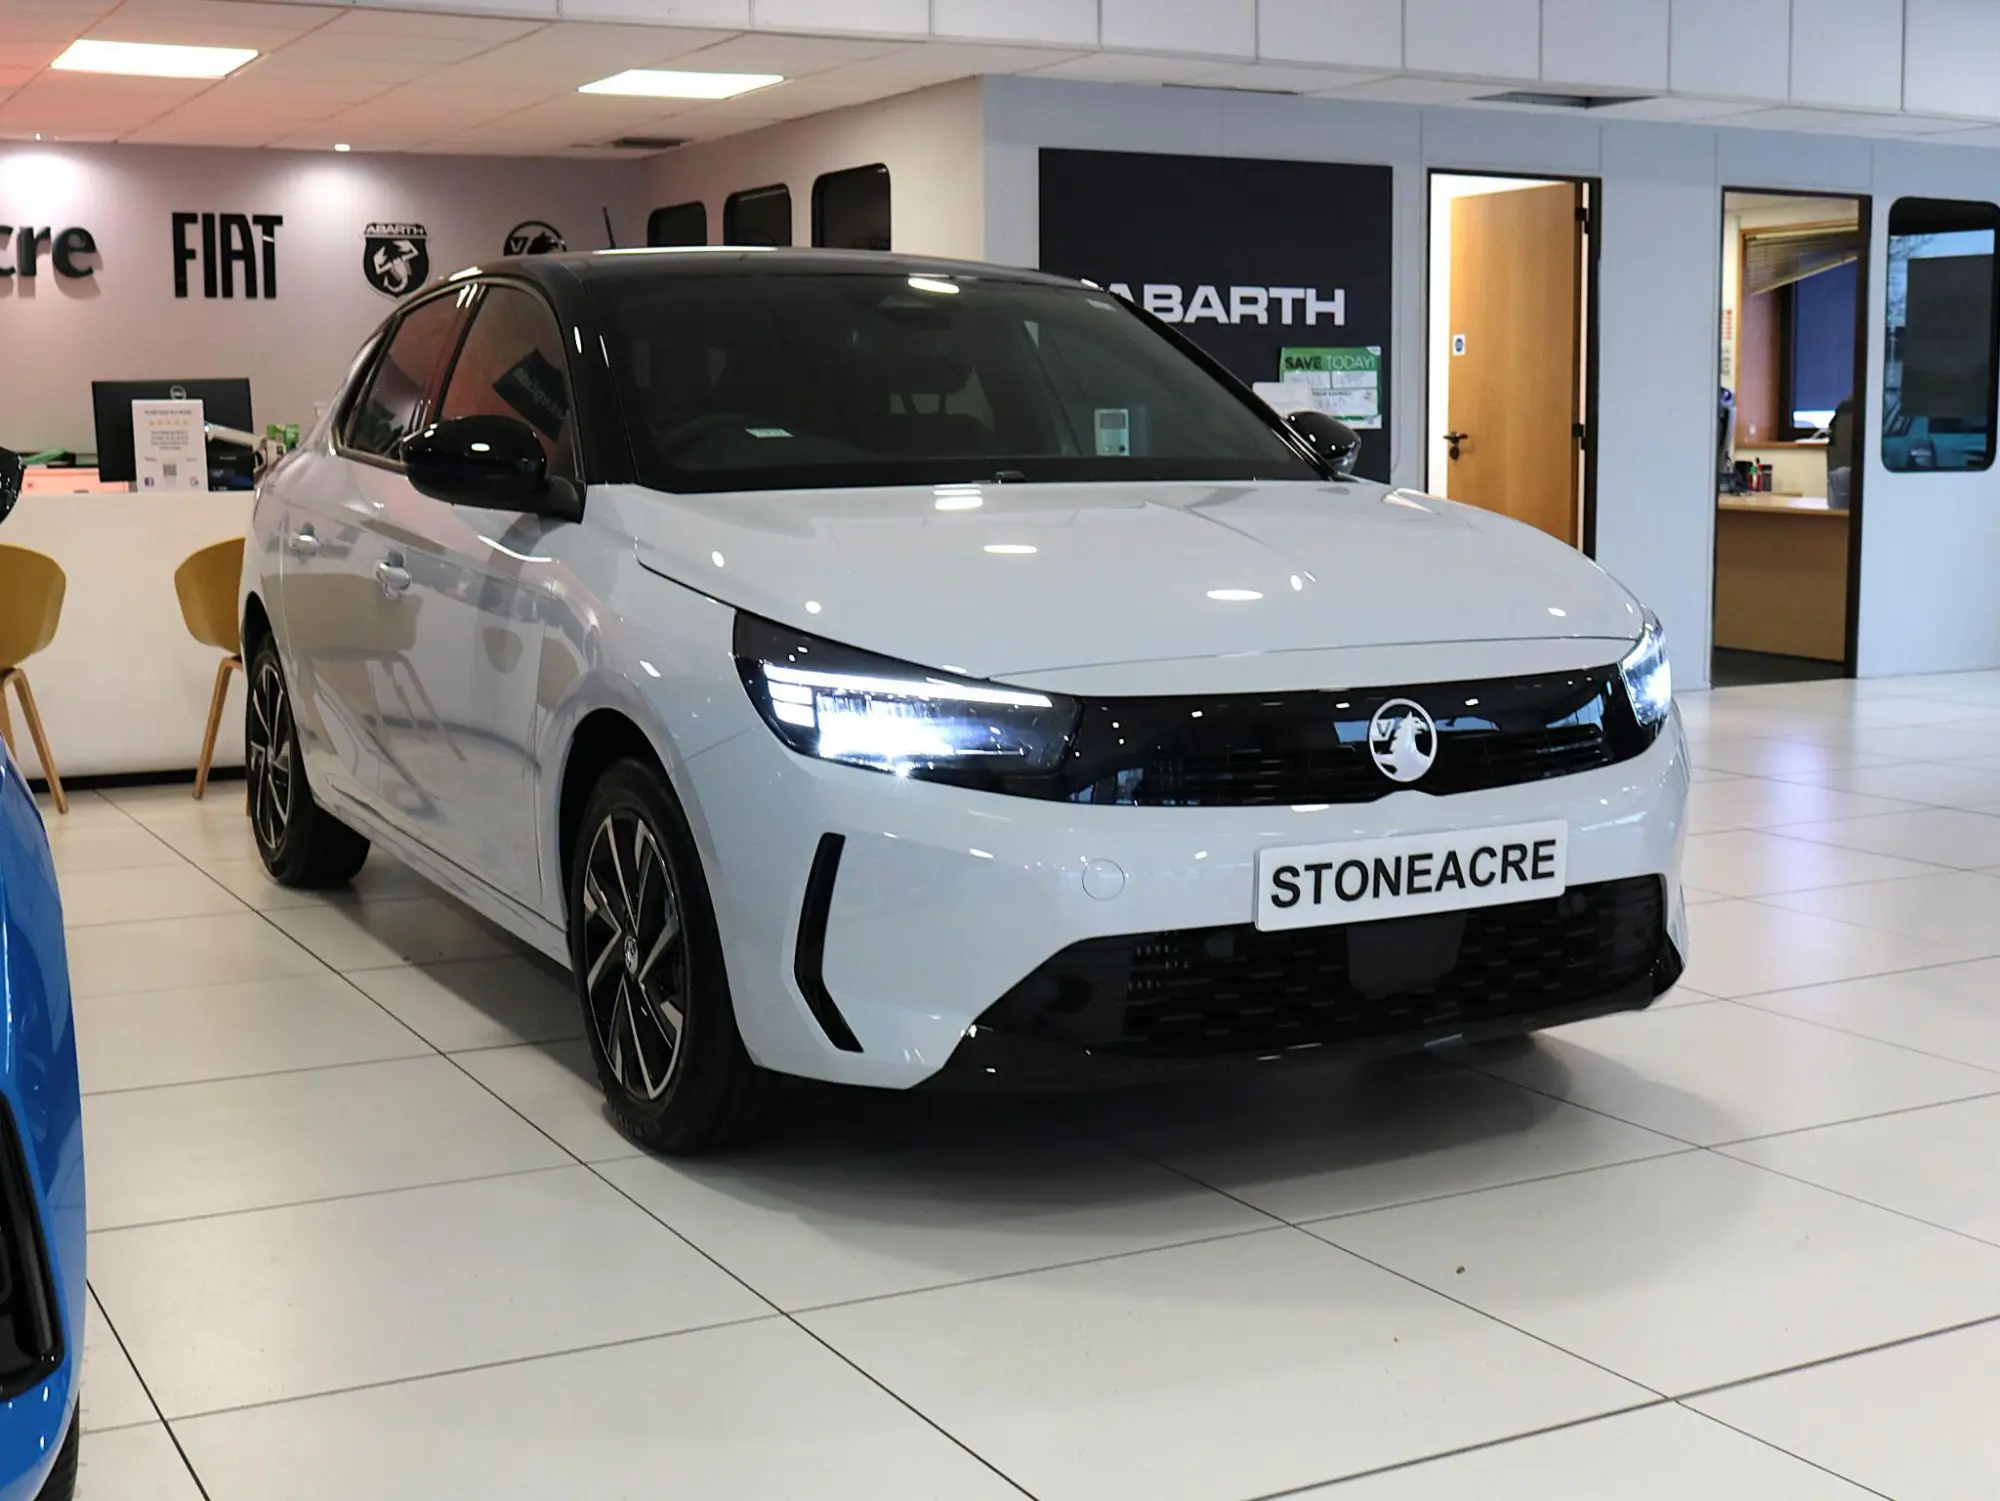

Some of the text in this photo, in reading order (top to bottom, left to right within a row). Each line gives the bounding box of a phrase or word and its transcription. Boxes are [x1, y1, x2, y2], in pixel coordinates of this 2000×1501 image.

[366, 223, 425, 236] ABARTH
[171, 212, 284, 300] FIAT
[1284, 355, 1376, 370] SAVE TODAY!
[1270, 838, 1557, 909] STONEACRE
